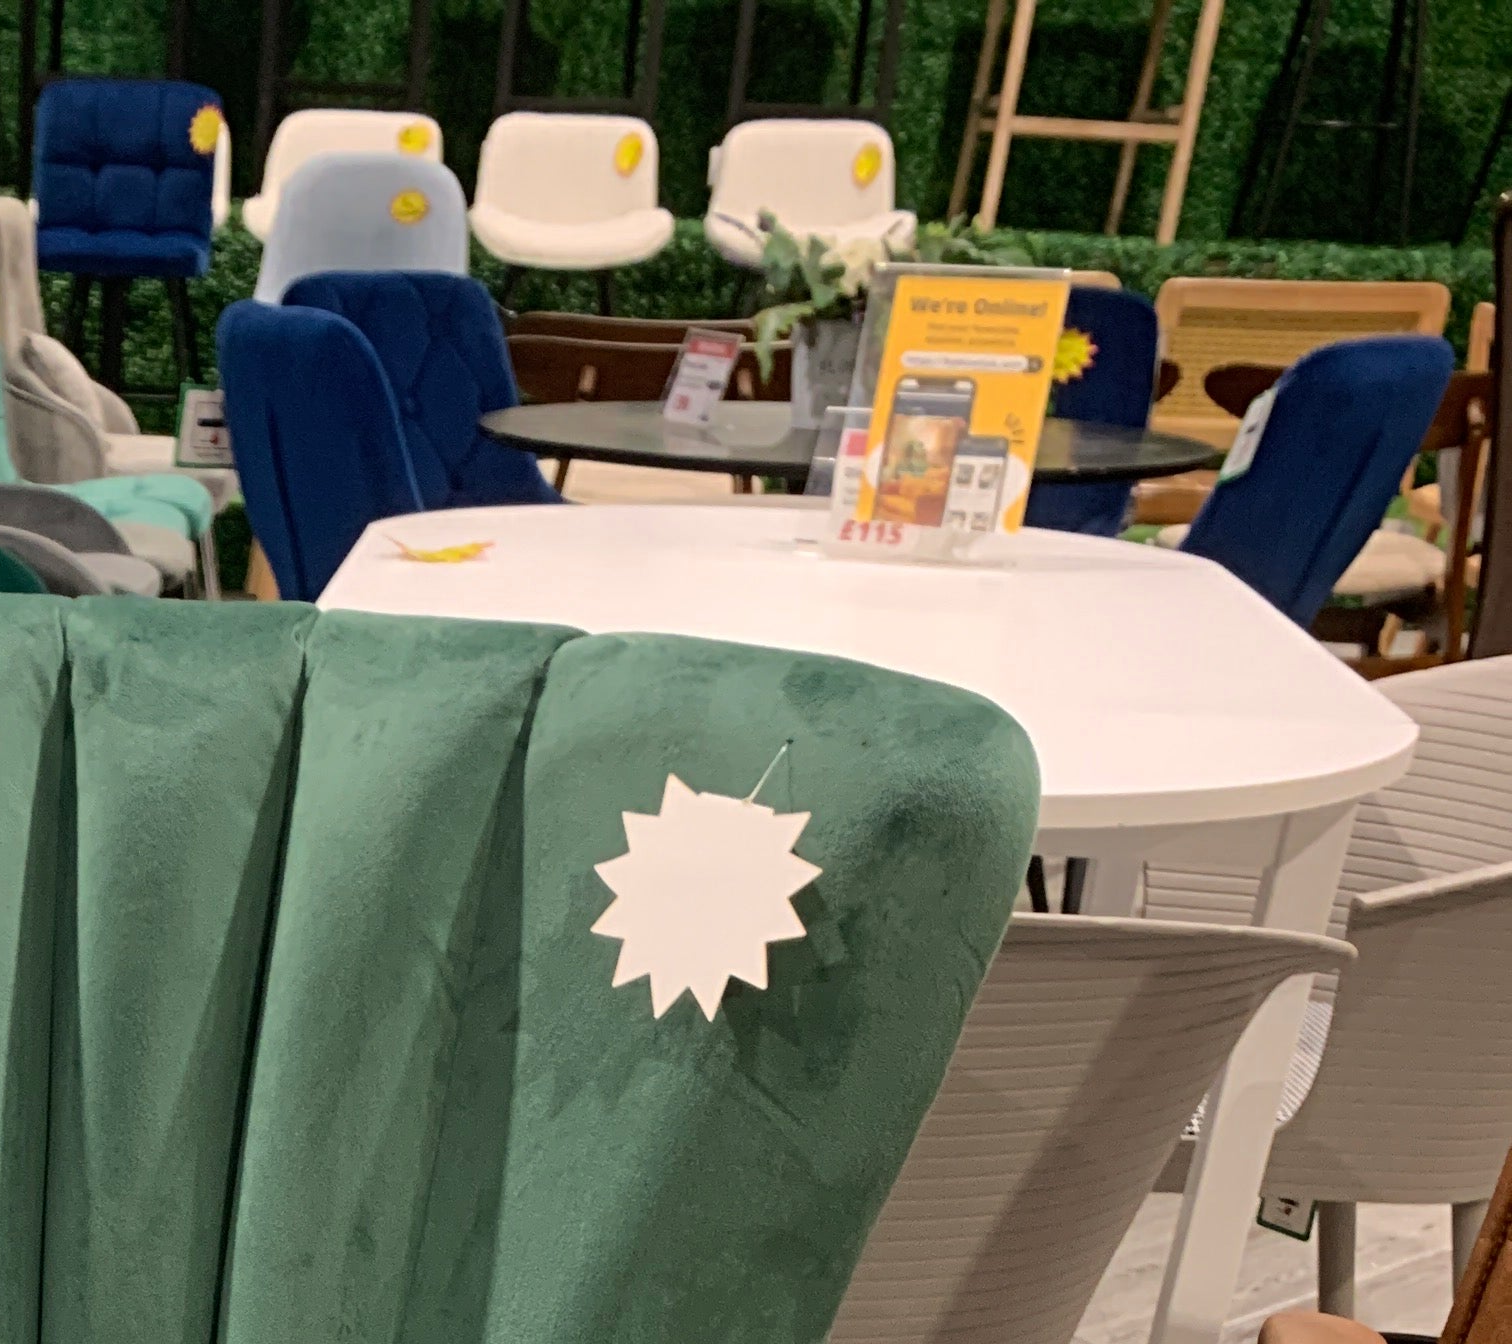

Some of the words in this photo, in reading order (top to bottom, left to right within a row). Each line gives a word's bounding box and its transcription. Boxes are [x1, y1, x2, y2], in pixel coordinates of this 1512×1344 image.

[910, 296, 968, 314] We're
[973, 298, 1048, 318] Online!
[839, 519, 903, 545] £115
